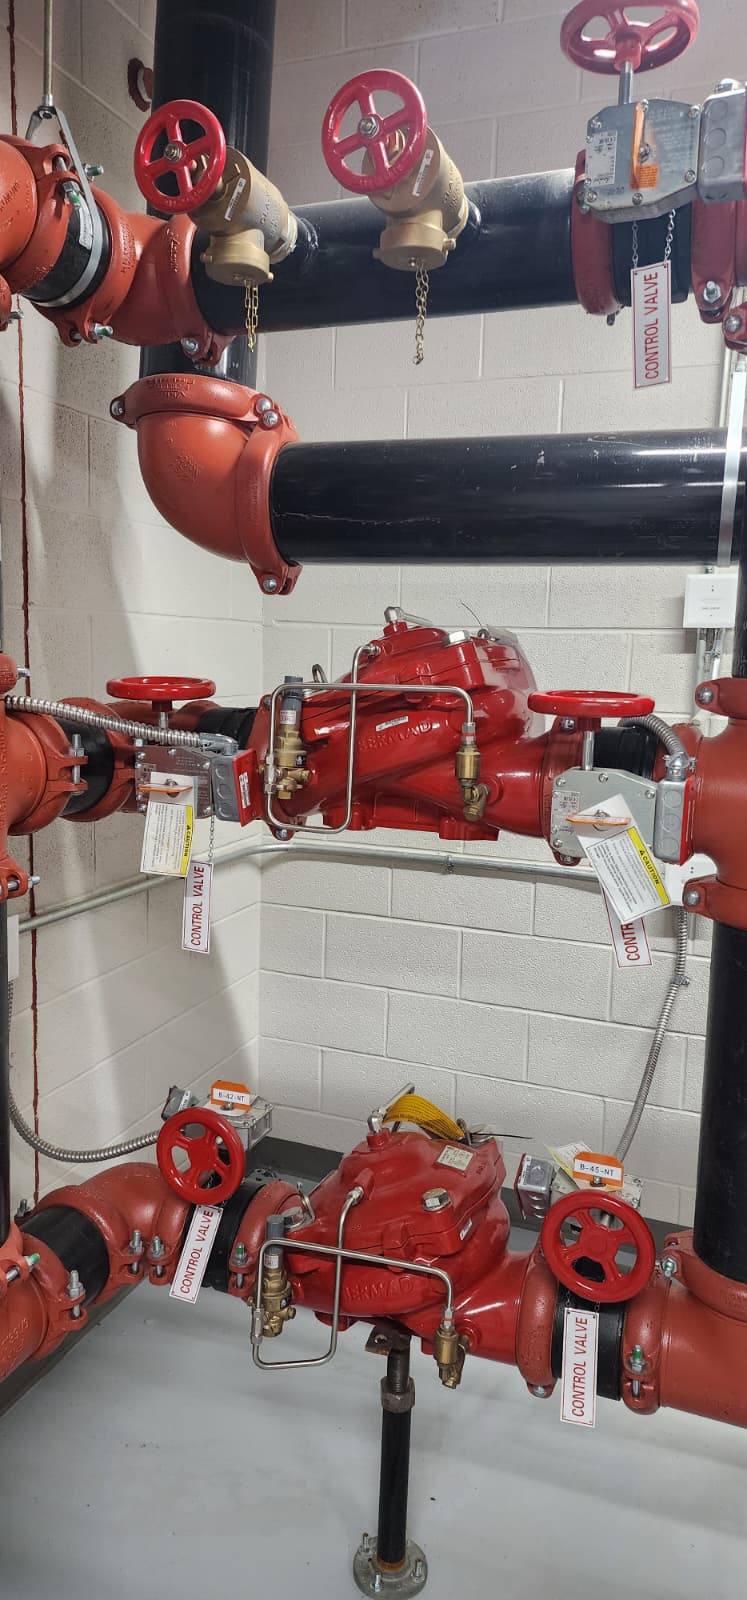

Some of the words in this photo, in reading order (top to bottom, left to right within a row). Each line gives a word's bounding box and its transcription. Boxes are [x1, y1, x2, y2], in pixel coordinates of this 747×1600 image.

[644, 271, 658, 316] VALVE
[644, 318, 659, 380] CONTROL
[193, 866, 205, 897] VALVE
[642, 856, 660, 885] CAUTION
[191, 900, 203, 946] CONTROL
[620, 922, 641, 961] CONTR
[580, 1163, 615, 1177] B-45-NT
[180, 1246, 203, 1294] CONTROL
[195, 1209, 214, 1243] VALVE
[574, 1316, 589, 1357] VALVE
[571, 1359, 587, 1417] CONTROL
